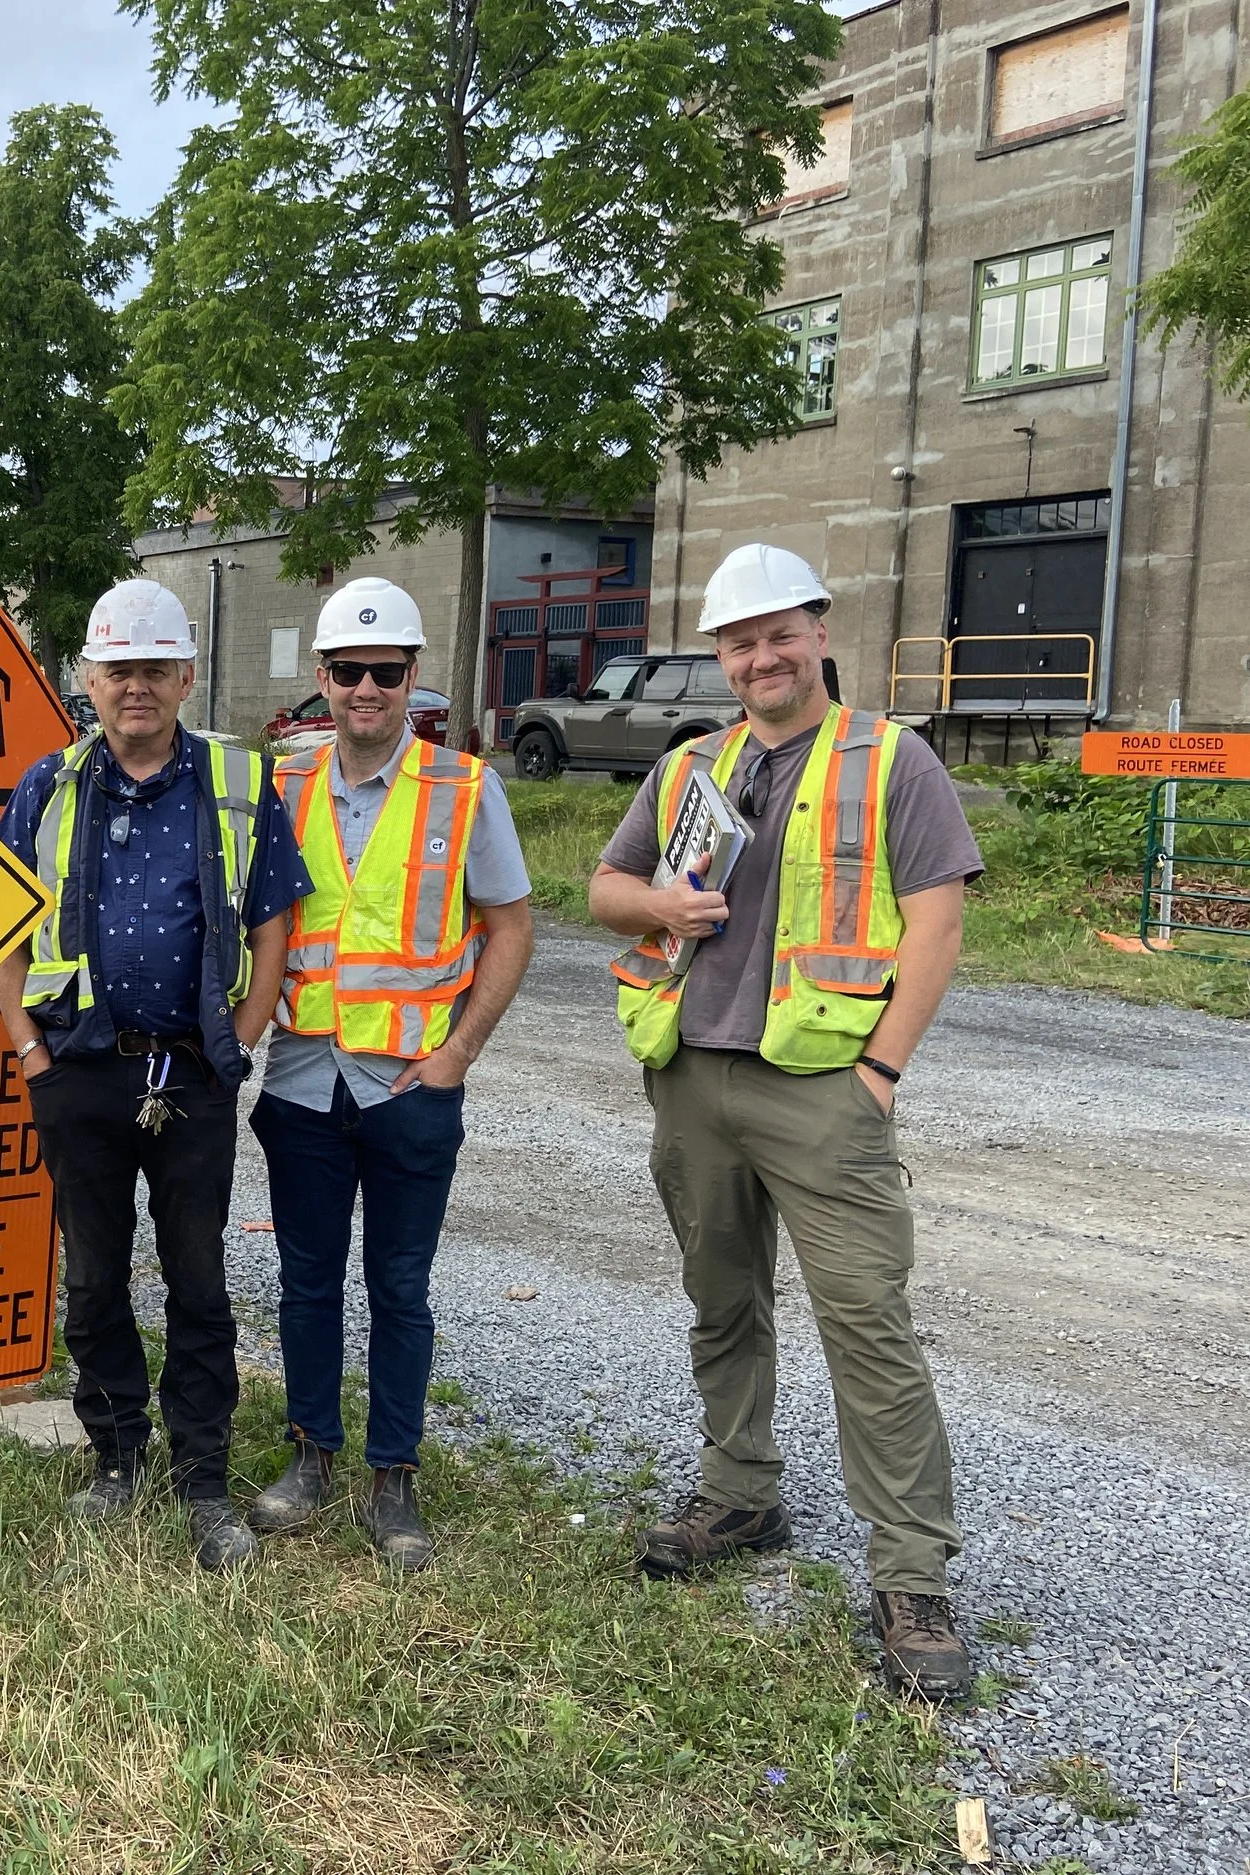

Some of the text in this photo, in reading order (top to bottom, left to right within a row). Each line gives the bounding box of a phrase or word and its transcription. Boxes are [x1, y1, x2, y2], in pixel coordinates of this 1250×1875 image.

[360, 611, 375, 621] cf
[1121, 736, 1224, 750] ROAD CLOSED
[1117, 758, 1227, 774] ROUTE FERMÉE
[669, 786, 699, 866] PELICAN
[691, 803, 709, 845] YETI
[432, 841, 444, 850] cf
